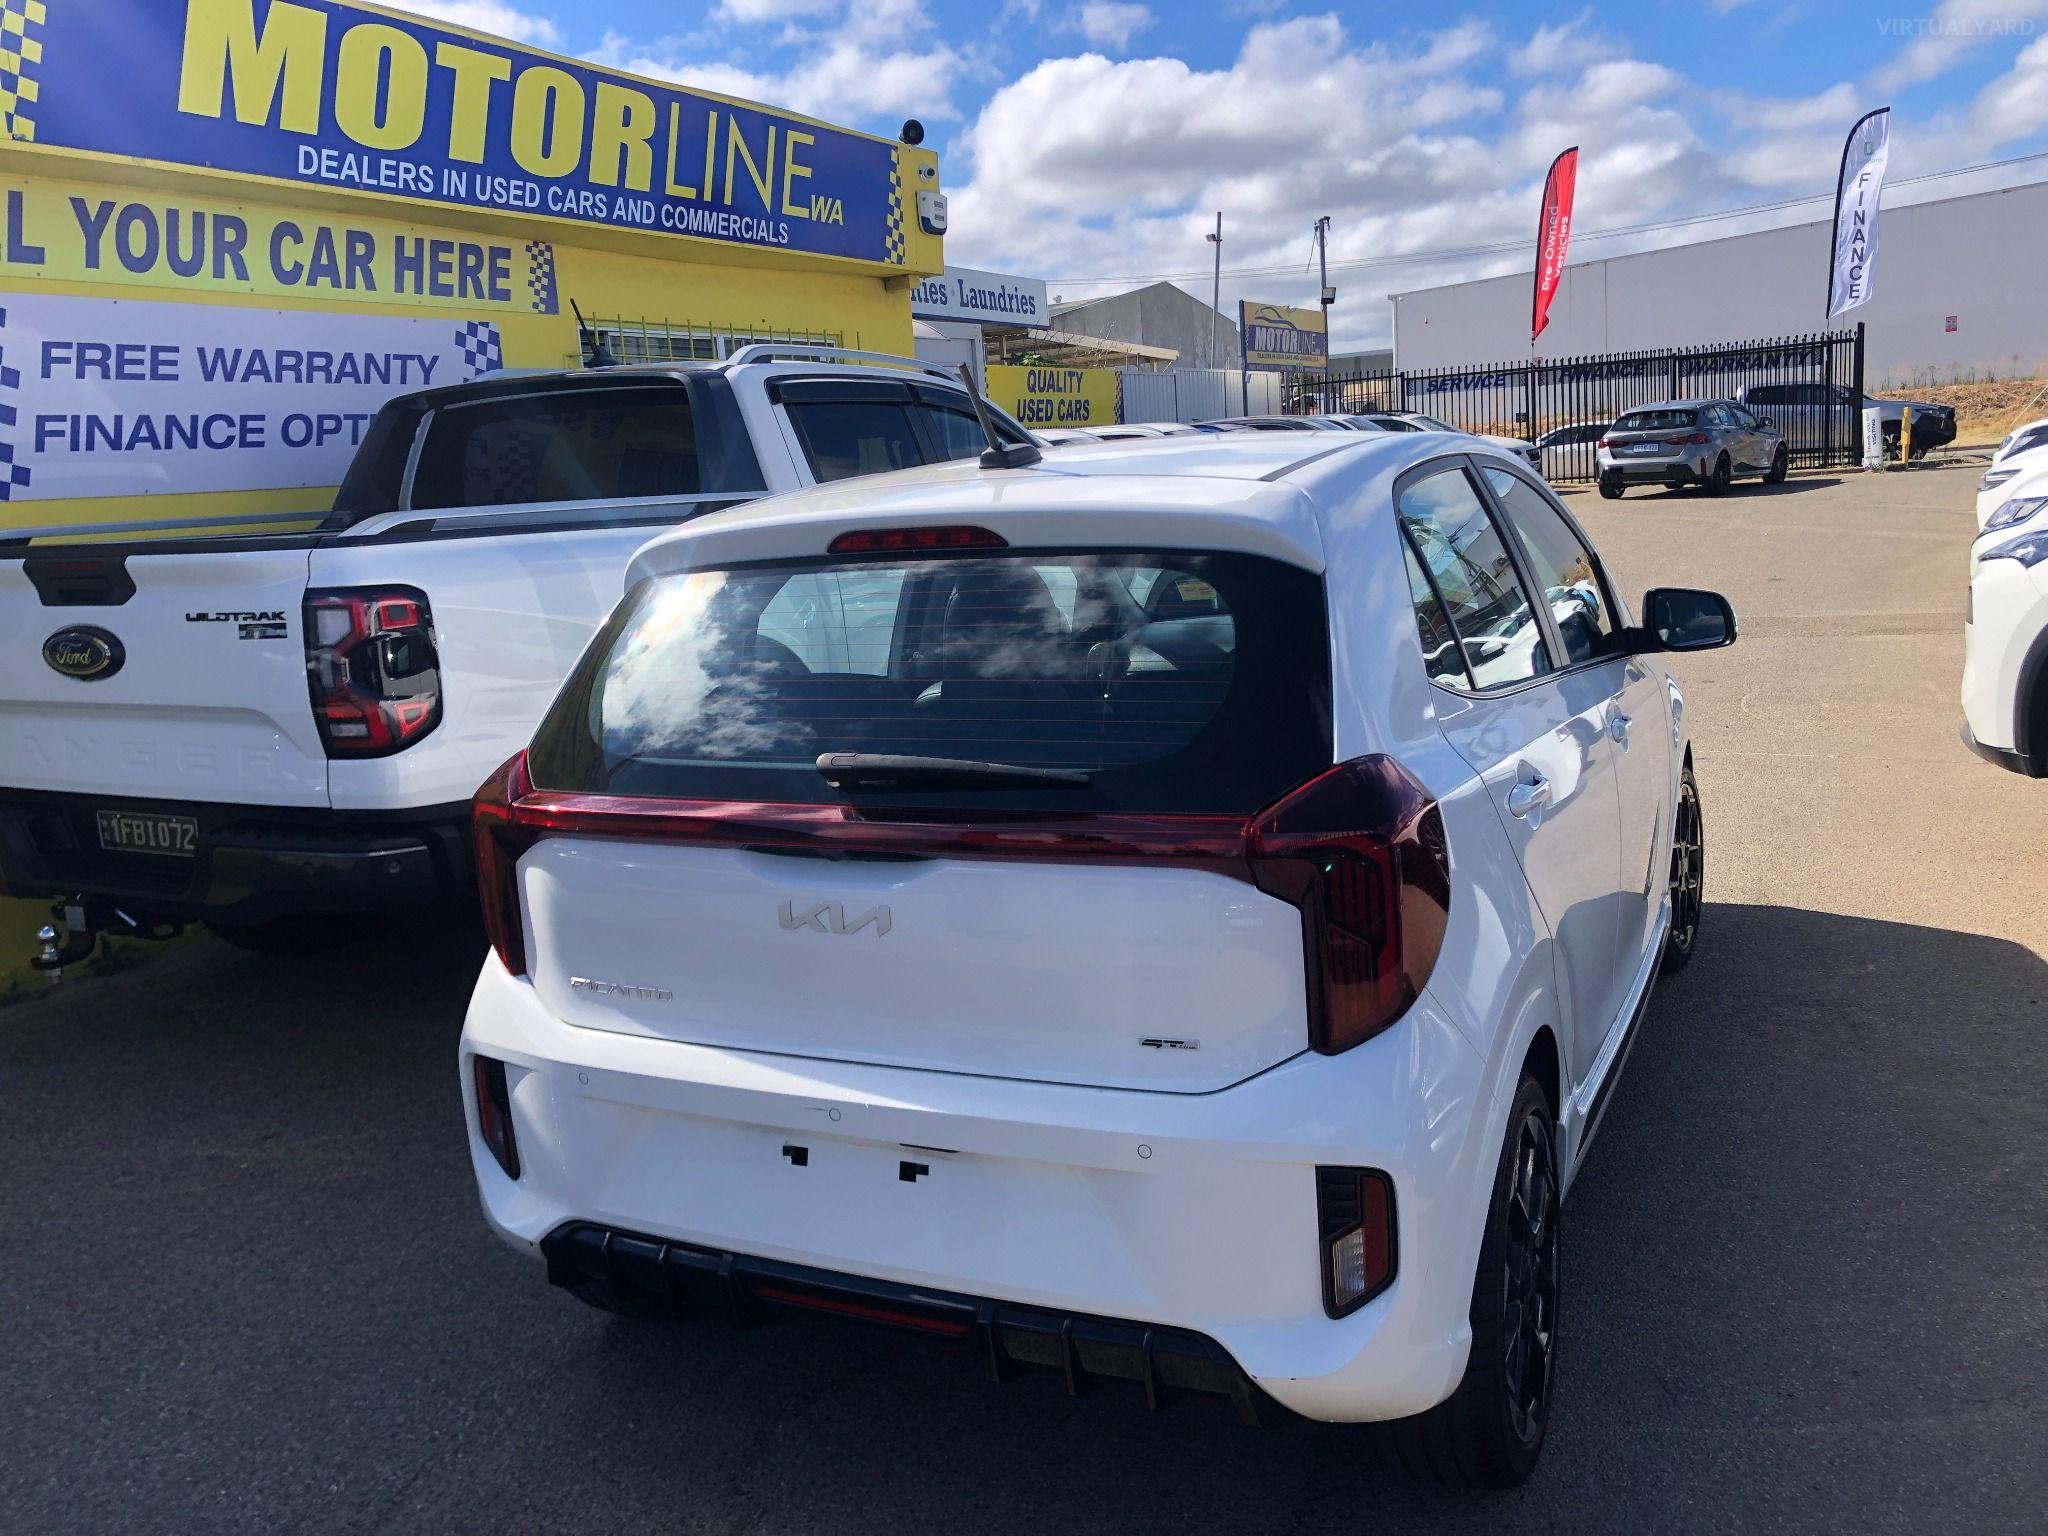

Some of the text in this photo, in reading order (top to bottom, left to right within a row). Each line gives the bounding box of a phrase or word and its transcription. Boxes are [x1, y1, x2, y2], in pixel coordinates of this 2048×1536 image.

[298, 145, 788, 244] DEALERS IN USED CARS AND COMMERCIALS
[811, 194, 844, 226] WA
[0, 190, 511, 299] L YOUR CAR HERE
[1542, 205, 1559, 291] Pre-Owned
[1849, 173, 1871, 299] FINANCE
[957, 279, 1036, 315] Laundries
[1255, 326, 1317, 354] MOTORLINE
[40, 341, 439, 385] FREE WARRANTY
[1027, 370, 1084, 394] QUALITY
[1427, 374, 1506, 392] SERVICE
[1017, 399, 1090, 422] USED CARS
[35, 413, 265, 452] FINANCE
[56, 642, 91, 664] Ford
[111, 818, 195, 850] 1FBI072
[570, 976, 673, 1002] PICANTO
